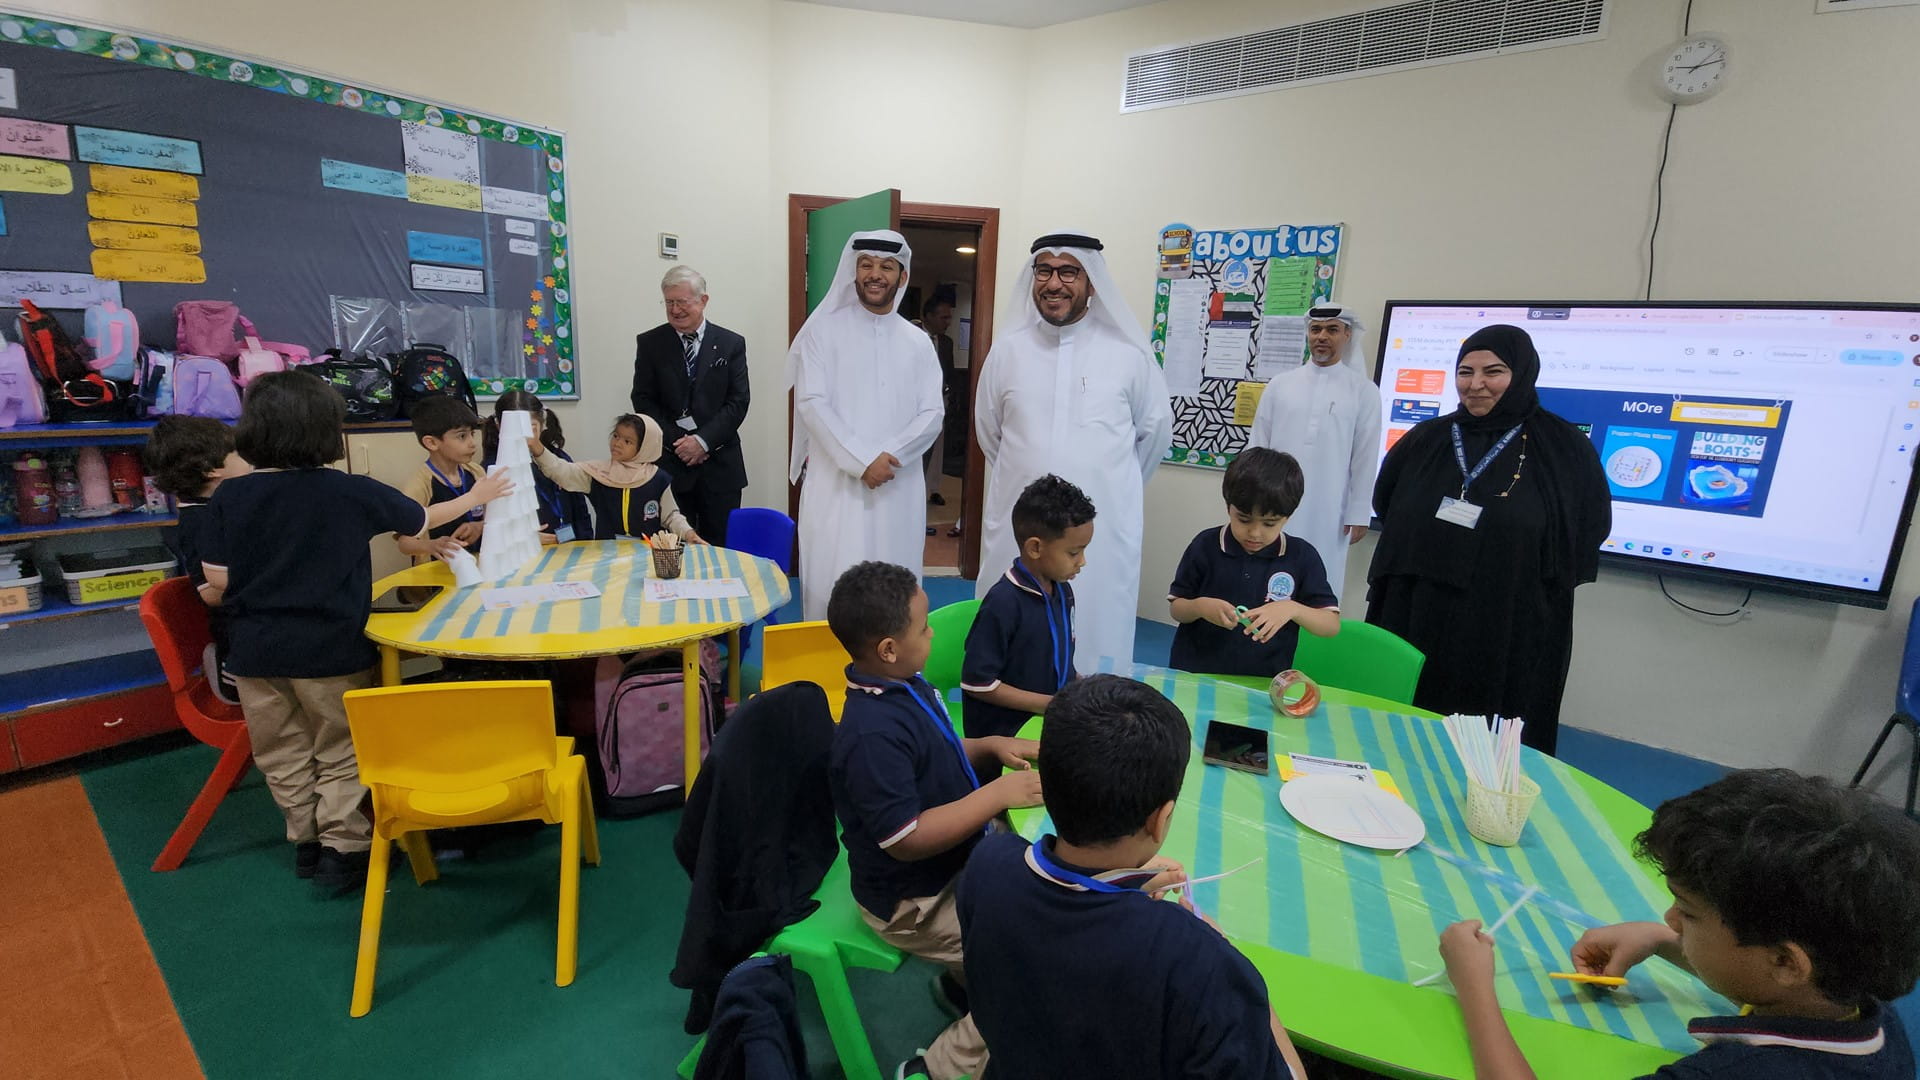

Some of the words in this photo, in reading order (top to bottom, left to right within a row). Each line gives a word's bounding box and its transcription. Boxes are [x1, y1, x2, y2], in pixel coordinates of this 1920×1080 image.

[1195, 225, 1291, 261] about
[1297, 229, 1336, 254] us
[1704, 444, 1751, 457] BOATS
[85, 575, 161, 595] Science
